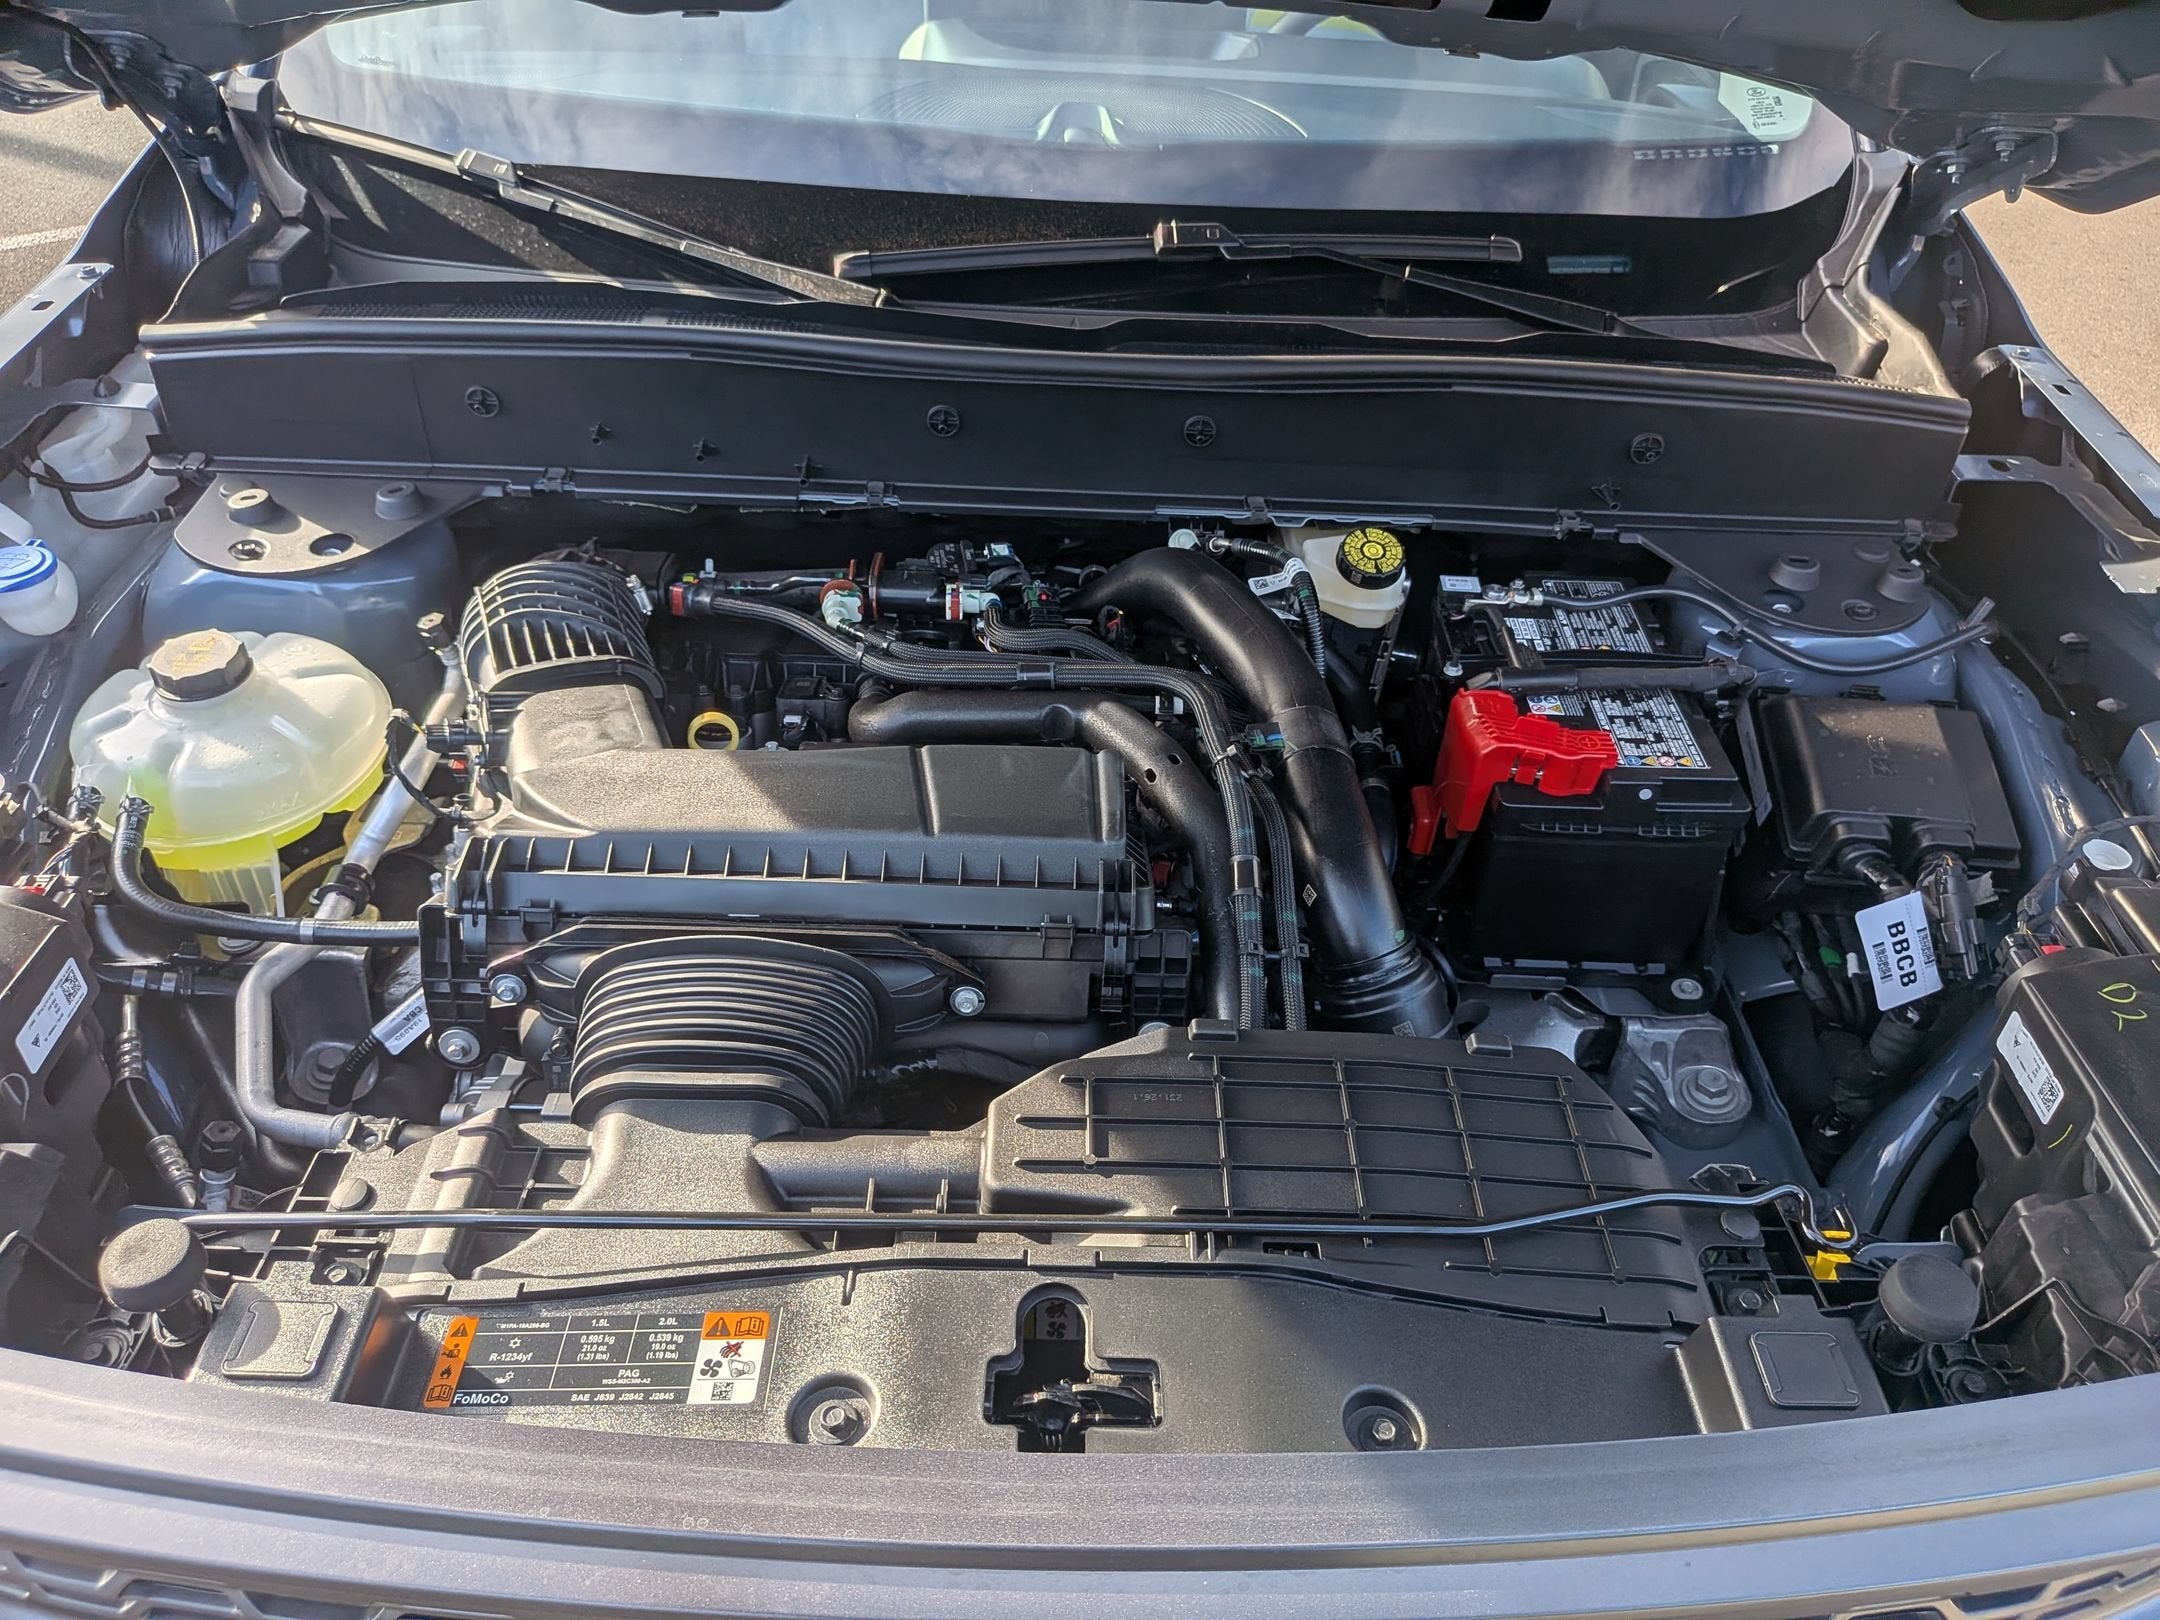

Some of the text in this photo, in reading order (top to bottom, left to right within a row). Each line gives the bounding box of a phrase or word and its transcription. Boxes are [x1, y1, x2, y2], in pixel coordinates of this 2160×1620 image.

[1887, 920, 1918, 987] BBCB
[403, 1005, 423, 1022] CBA
[591, 1319, 610, 1327] 1.5L
[658, 1317, 679, 1326] 2.0L
[580, 1334, 616, 1344] 0.595 kg
[648, 1333, 684, 1343] 0.539 kg
[581, 1344, 597, 1352] 21.0
[489, 1352, 534, 1362] R-1234yf
[577, 1352, 610, 1361] (1.31 lbs)
[645, 1351, 679, 1360] (1.19 lbs)
[617, 1369, 640, 1378] PAG
[452, 1393, 509, 1405] FoMoCo
[571, 1393, 590, 1402] SAE
[594, 1393, 615, 1401] J639
[649, 1392, 675, 1400] J2845
